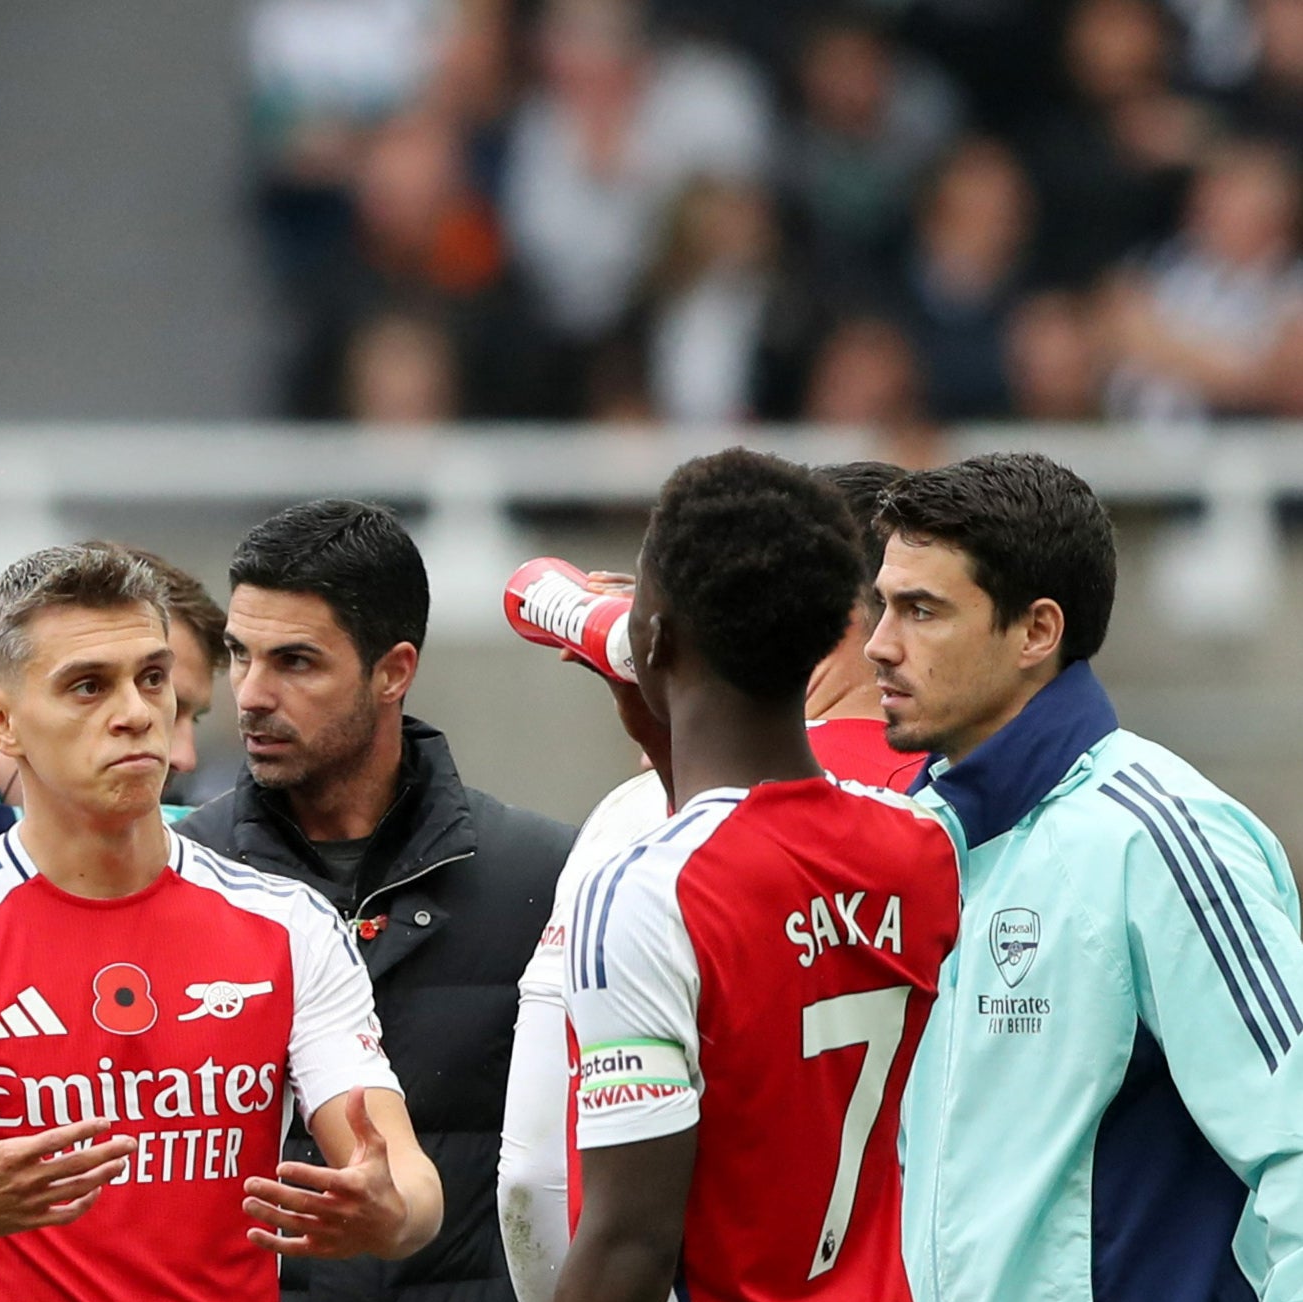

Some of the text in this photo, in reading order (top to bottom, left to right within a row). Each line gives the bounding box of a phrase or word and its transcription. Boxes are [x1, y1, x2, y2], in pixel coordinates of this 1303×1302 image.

[785, 891, 902, 968] SAKA
[977, 994, 1051, 1015] Emirates
[1007, 1017, 1043, 1034] BETTER
[802, 984, 913, 1281] 7
